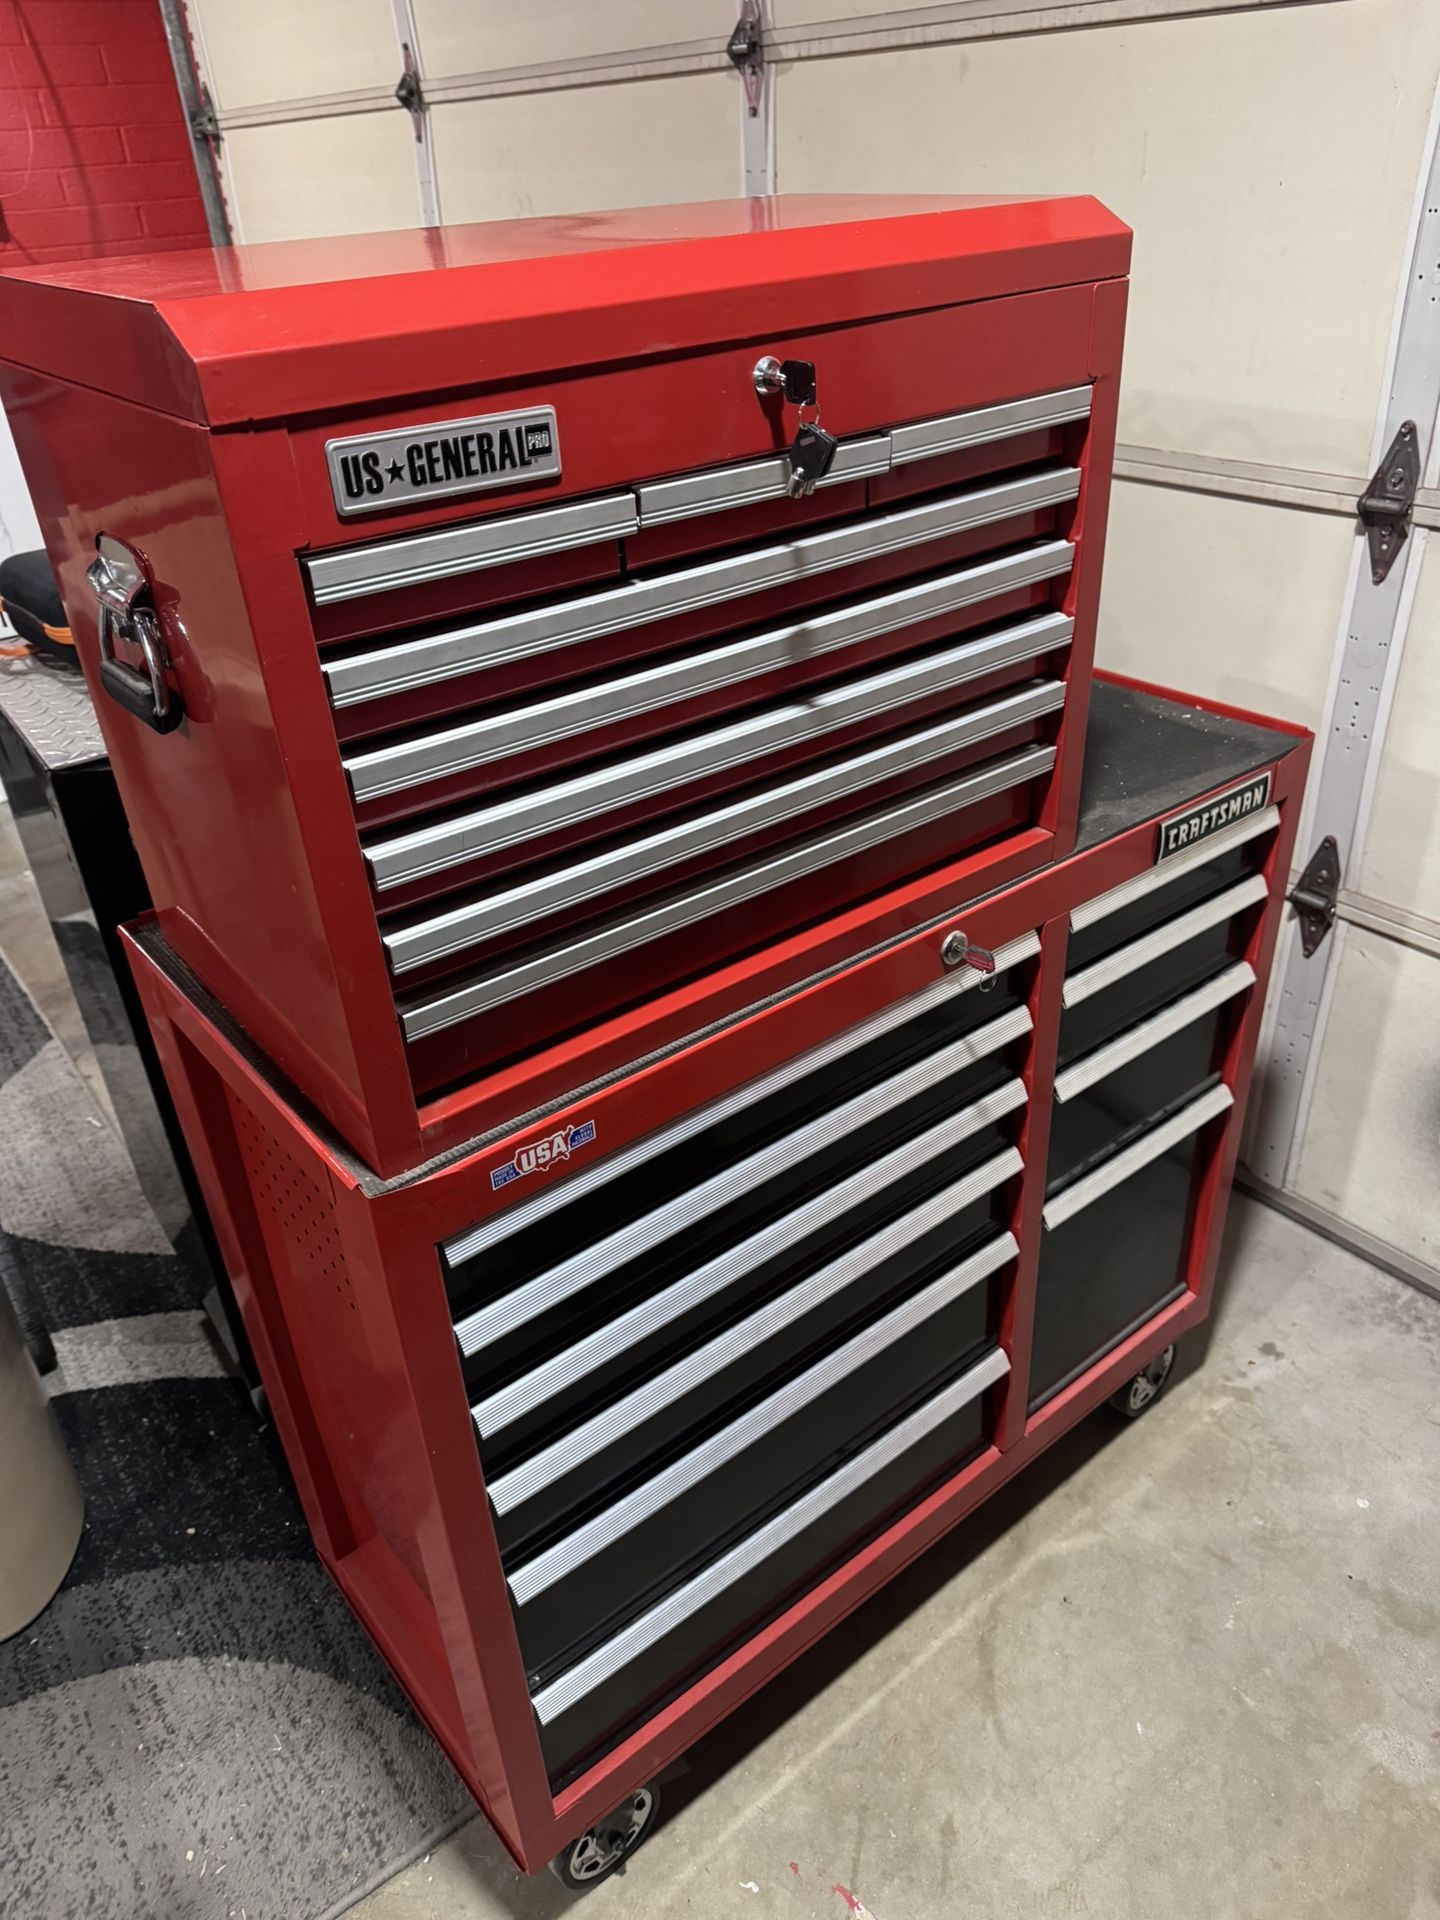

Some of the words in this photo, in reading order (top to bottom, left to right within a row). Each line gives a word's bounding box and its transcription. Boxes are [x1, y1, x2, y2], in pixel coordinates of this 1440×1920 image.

[340, 451, 384, 498] US
[406, 426, 532, 487] GENERAL
[527, 430, 550, 449] PRO
[1168, 785, 1264, 850] CRAFTSMAN
[521, 1136, 567, 1171] USA
